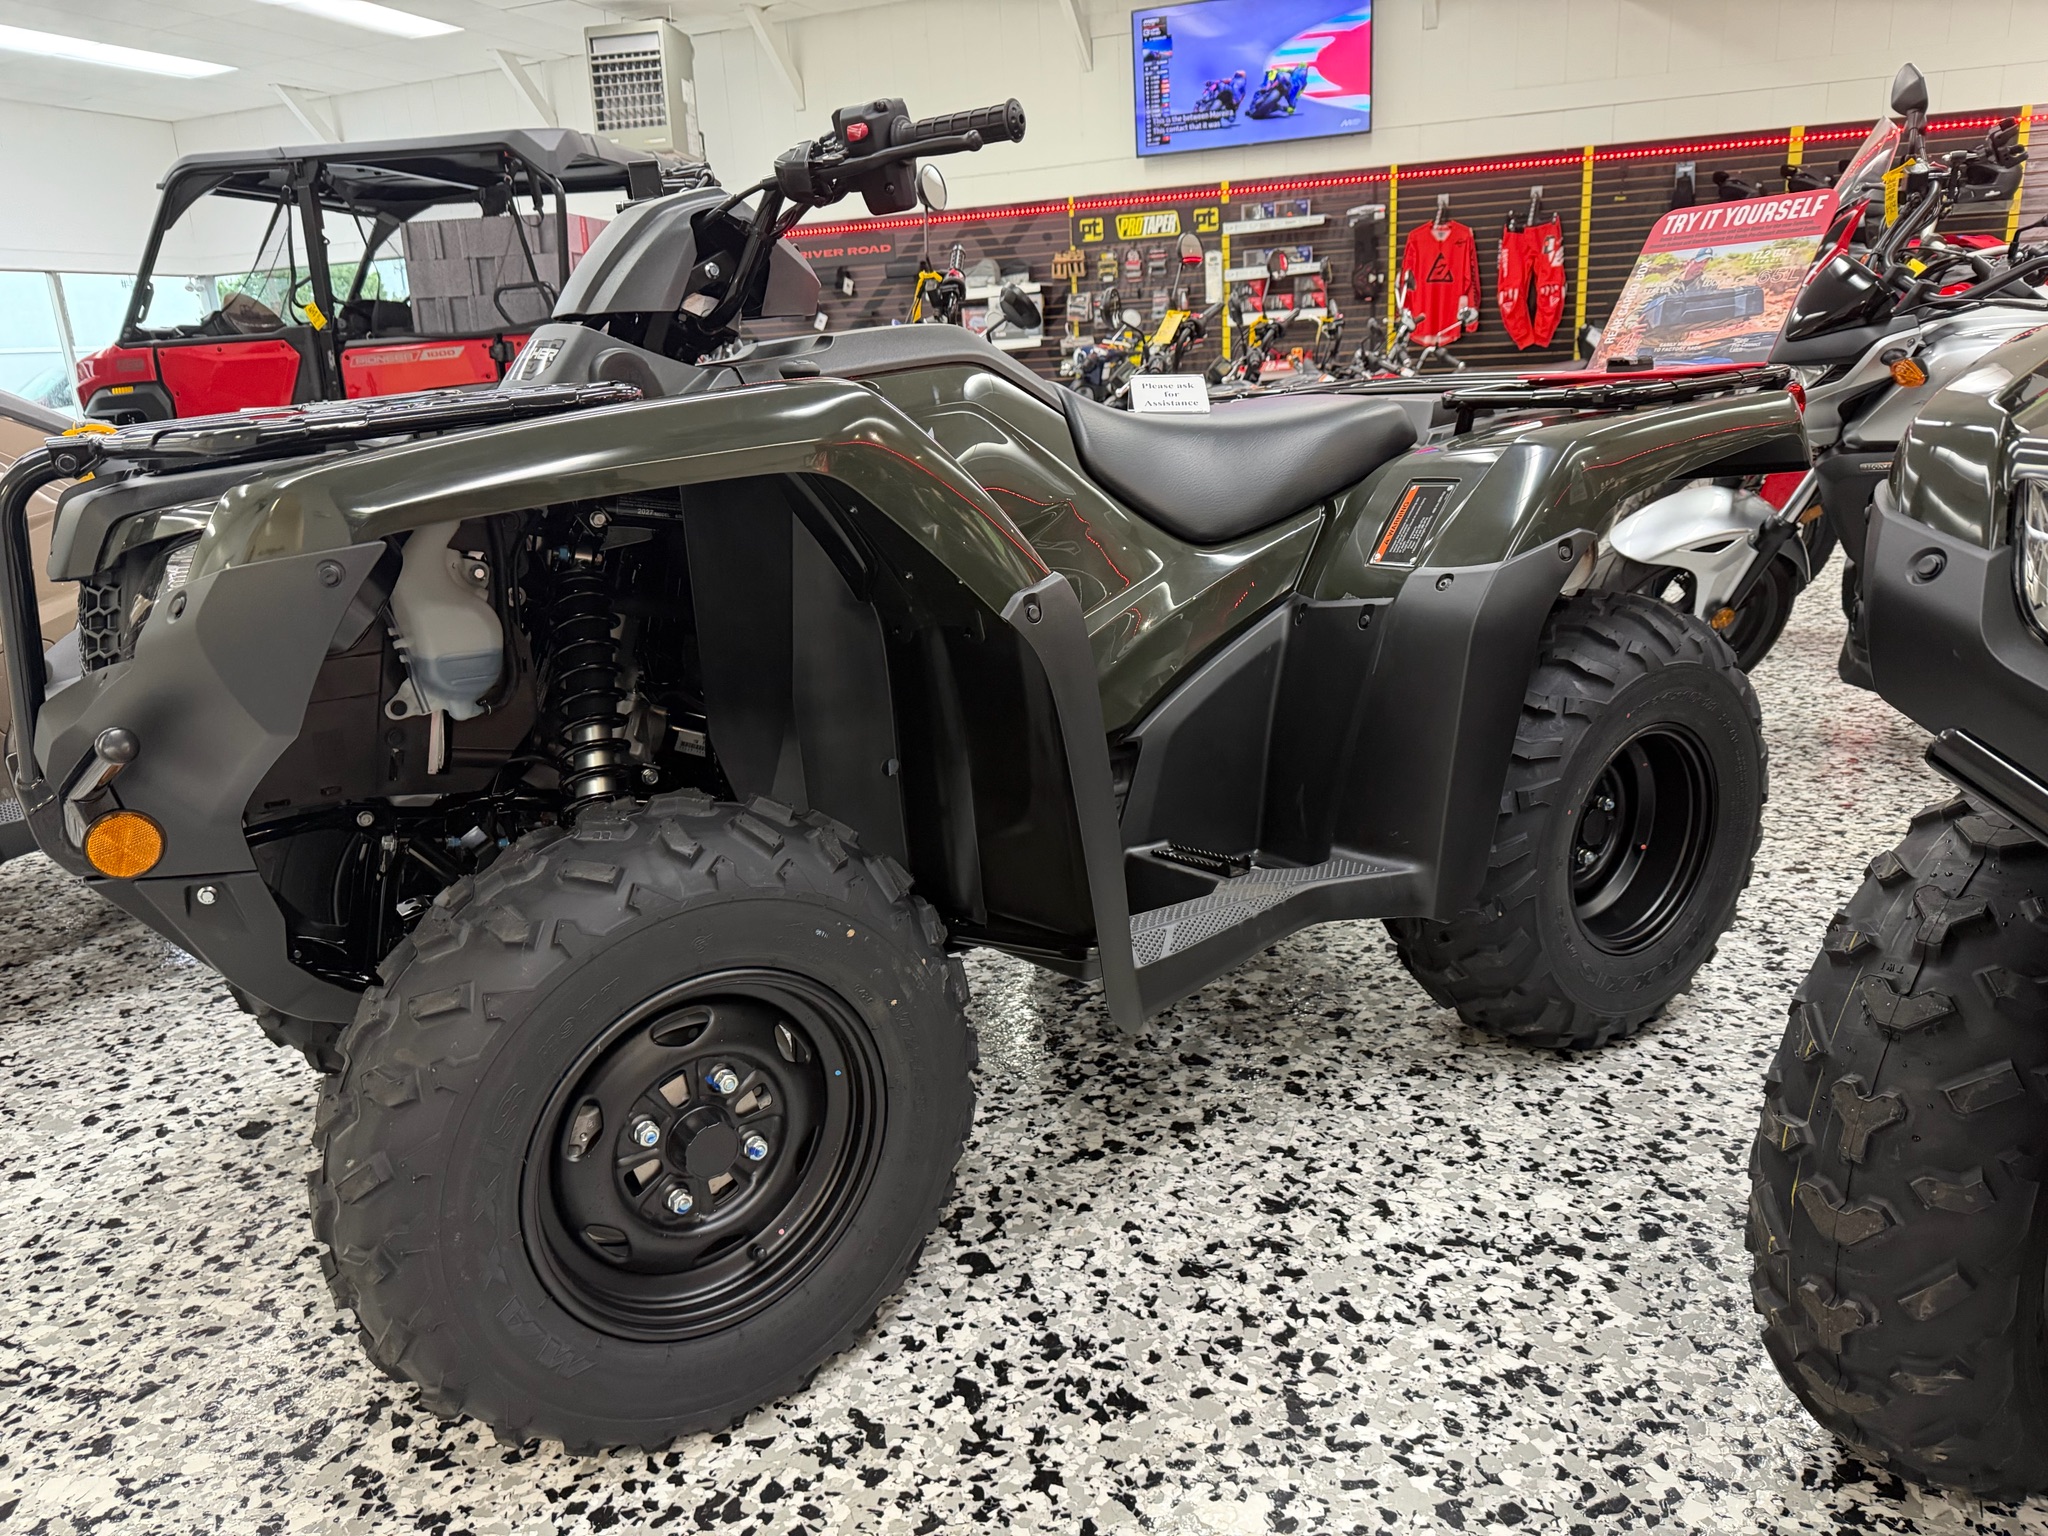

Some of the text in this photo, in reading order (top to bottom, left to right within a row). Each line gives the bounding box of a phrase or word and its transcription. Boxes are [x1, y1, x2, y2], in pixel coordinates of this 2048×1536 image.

[1153, 117, 1165, 125] This
[1172, 115, 1182, 123] the
[1183, 112, 1209, 121] between
[1153, 121, 1221, 135] This contact that it was
[1662, 211, 1703, 236] TRY
[1699, 208, 1724, 231] IT
[1722, 194, 1830, 229] YOURSELF
[1120, 213, 1178, 237] PROTAPER
[800, 244, 892, 259] RIVER ROAD
[1751, 247, 1793, 260] 17.2 GAL
[1604, 260, 1652, 345] REAR CARGO BOX
[425, 349, 456, 358] 1000
[1164, 390, 1180, 398] for
[1144, 399, 1199, 407] Assistance
[1387, 501, 1410, 539] WARNING
[1577, 912, 1707, 993] MAXXIS
